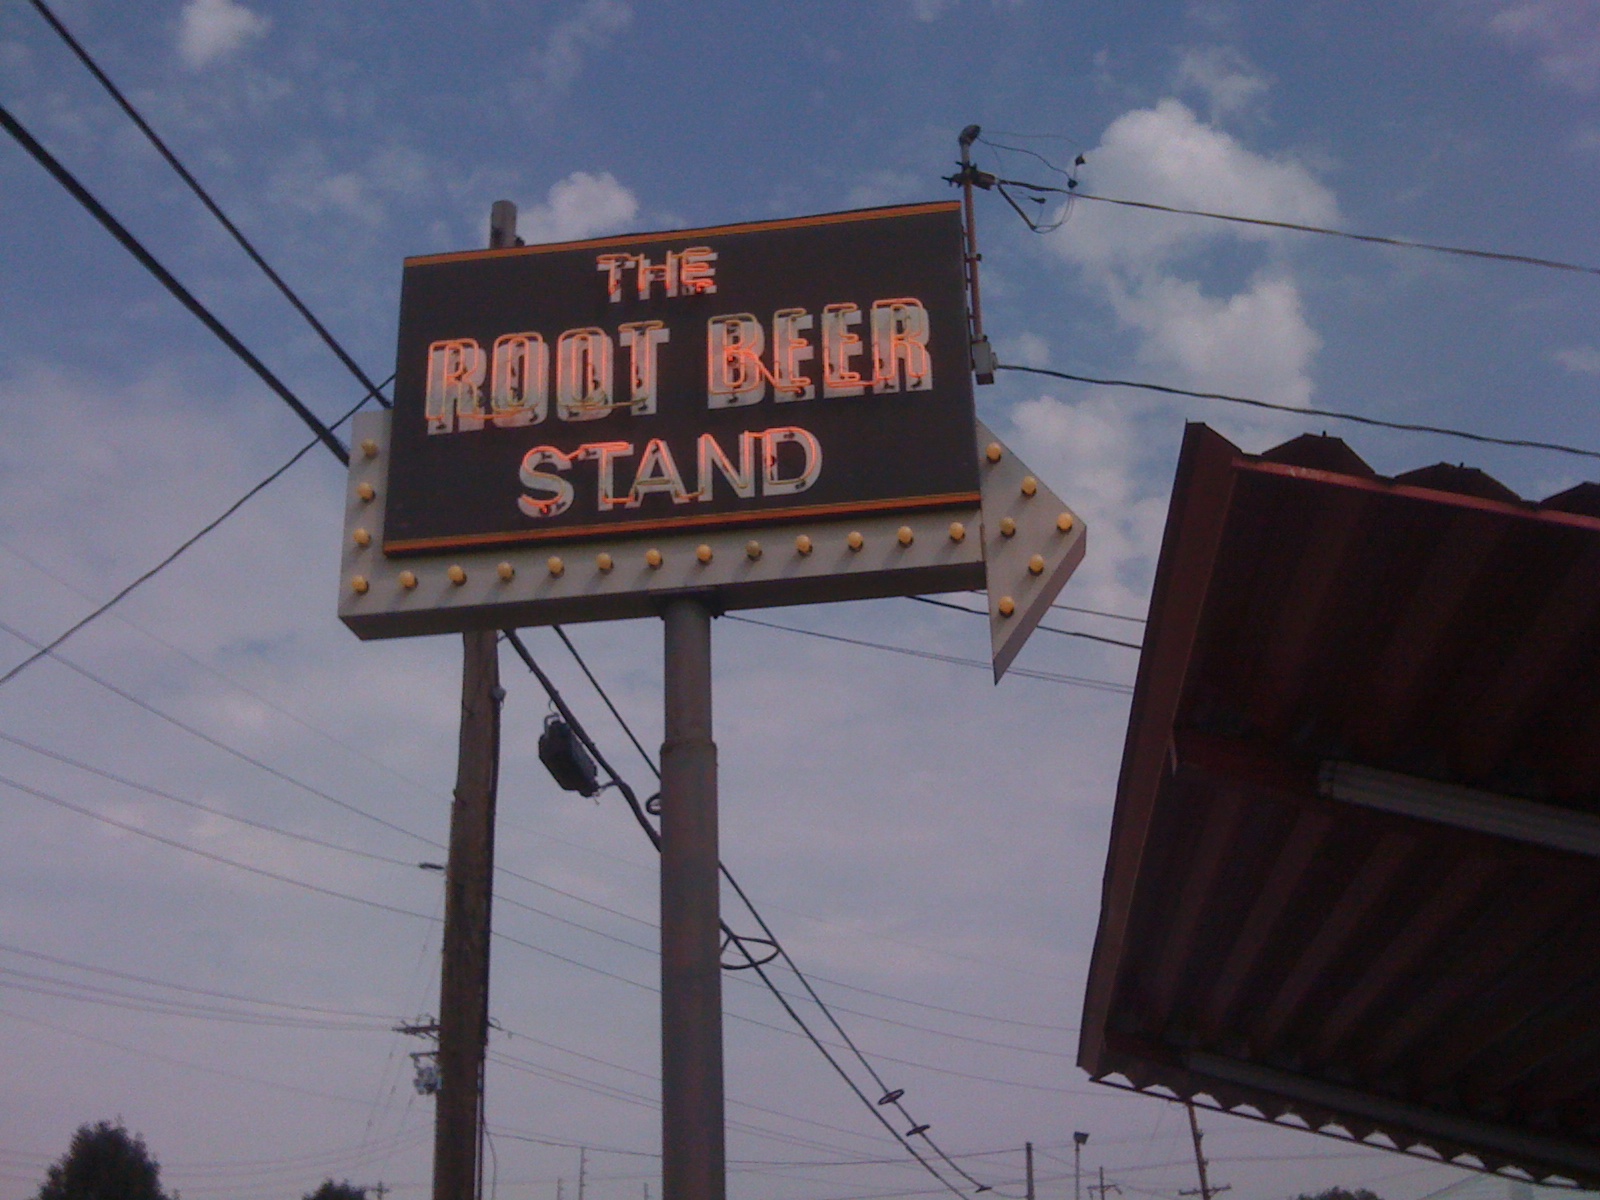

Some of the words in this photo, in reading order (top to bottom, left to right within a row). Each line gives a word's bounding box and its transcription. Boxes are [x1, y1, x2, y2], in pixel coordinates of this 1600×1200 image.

[596, 246, 718, 303] THE
[425, 319, 670, 435] ROOT
[707, 297, 934, 410] BEER
[518, 426, 823, 518] STAND
